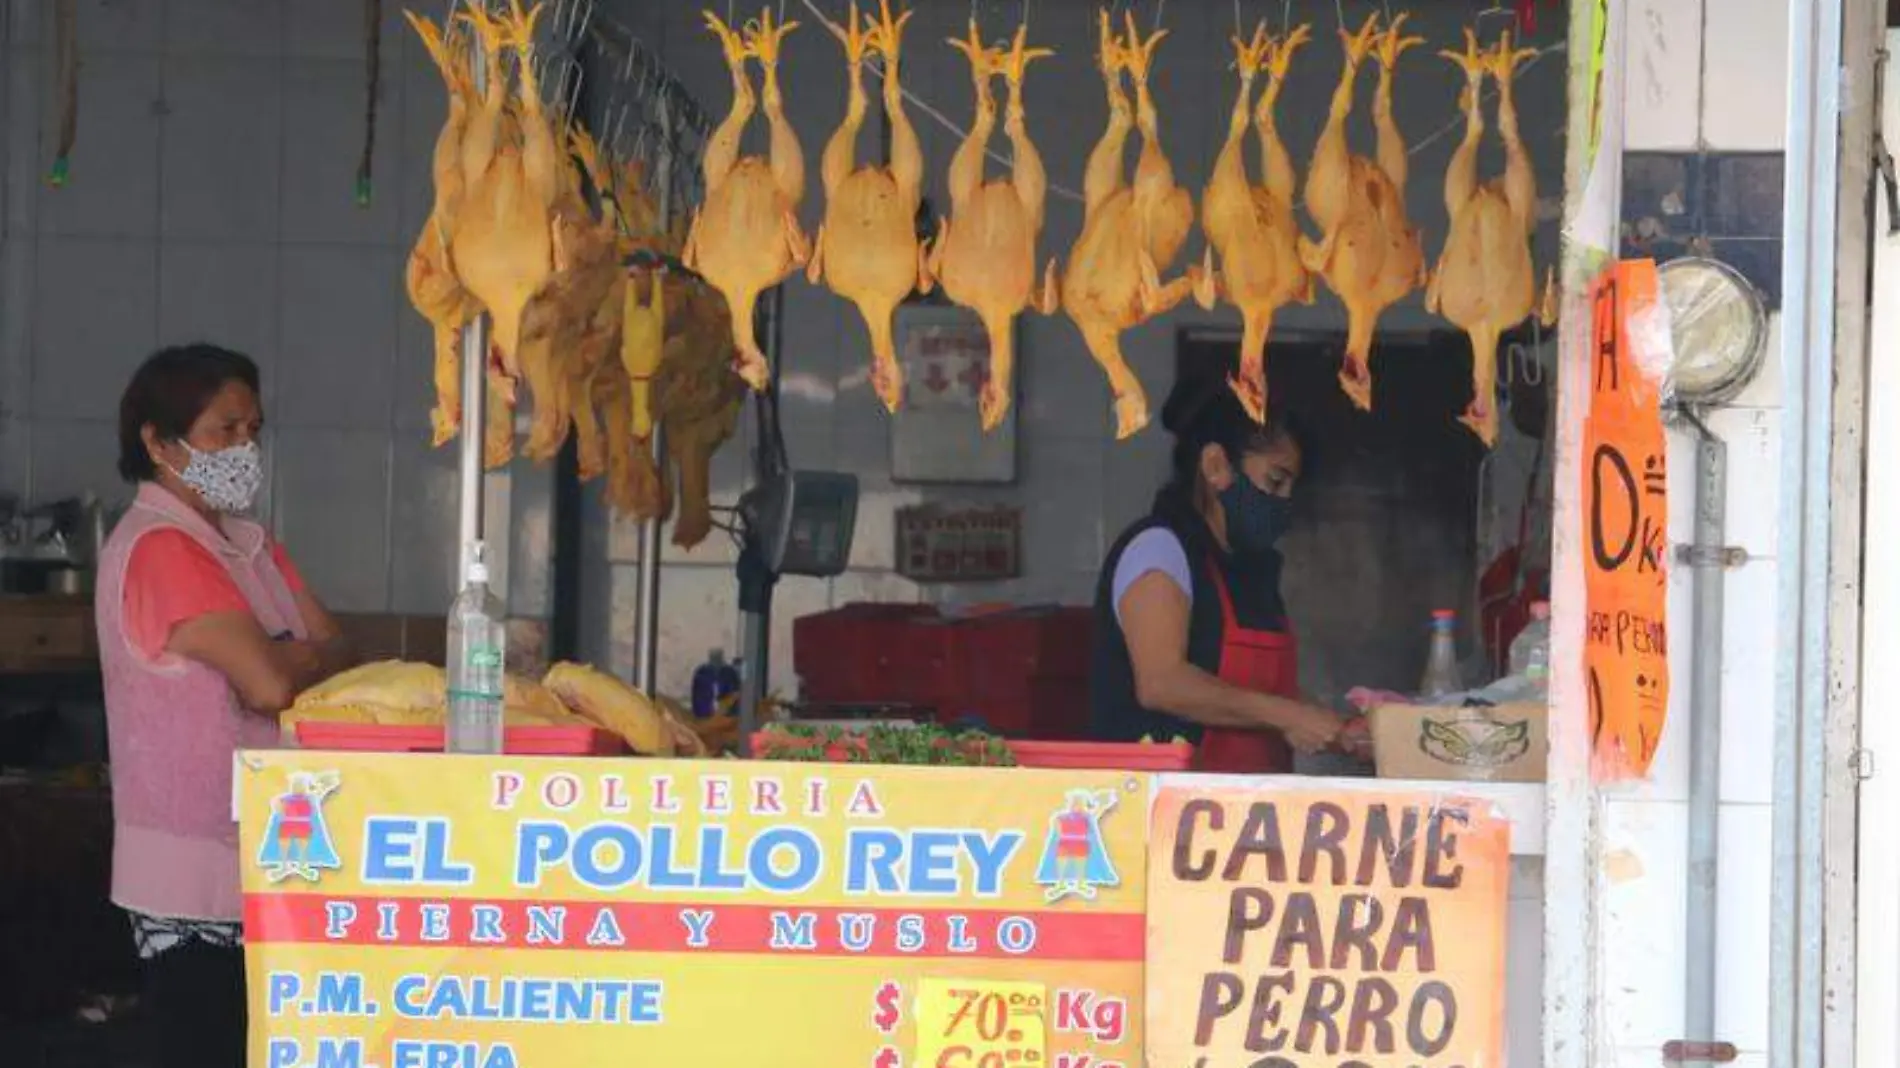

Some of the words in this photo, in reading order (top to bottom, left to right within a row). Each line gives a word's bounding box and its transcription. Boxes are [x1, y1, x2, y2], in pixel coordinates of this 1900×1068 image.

[495, 774, 881, 814] POLLERIA
[364, 818, 473, 884] EL
[515, 822, 822, 891] POLLO
[845, 830, 1023, 895] REY
[1171, 798, 1469, 889] CARNE
[327, 903, 626, 945] PIERNA
[682, 911, 713, 946] Y
[773, 914, 1036, 951] MUSLO
[1222, 886, 1436, 974] PARA
[268, 972, 378, 1017] P.M.
[393, 975, 662, 1022] CALIENTE
[873, 981, 901, 1032] $
[1056, 990, 1127, 1041] Kg
[1193, 970, 1458, 1058] PERRO
[269, 1038, 380, 1068] PM
